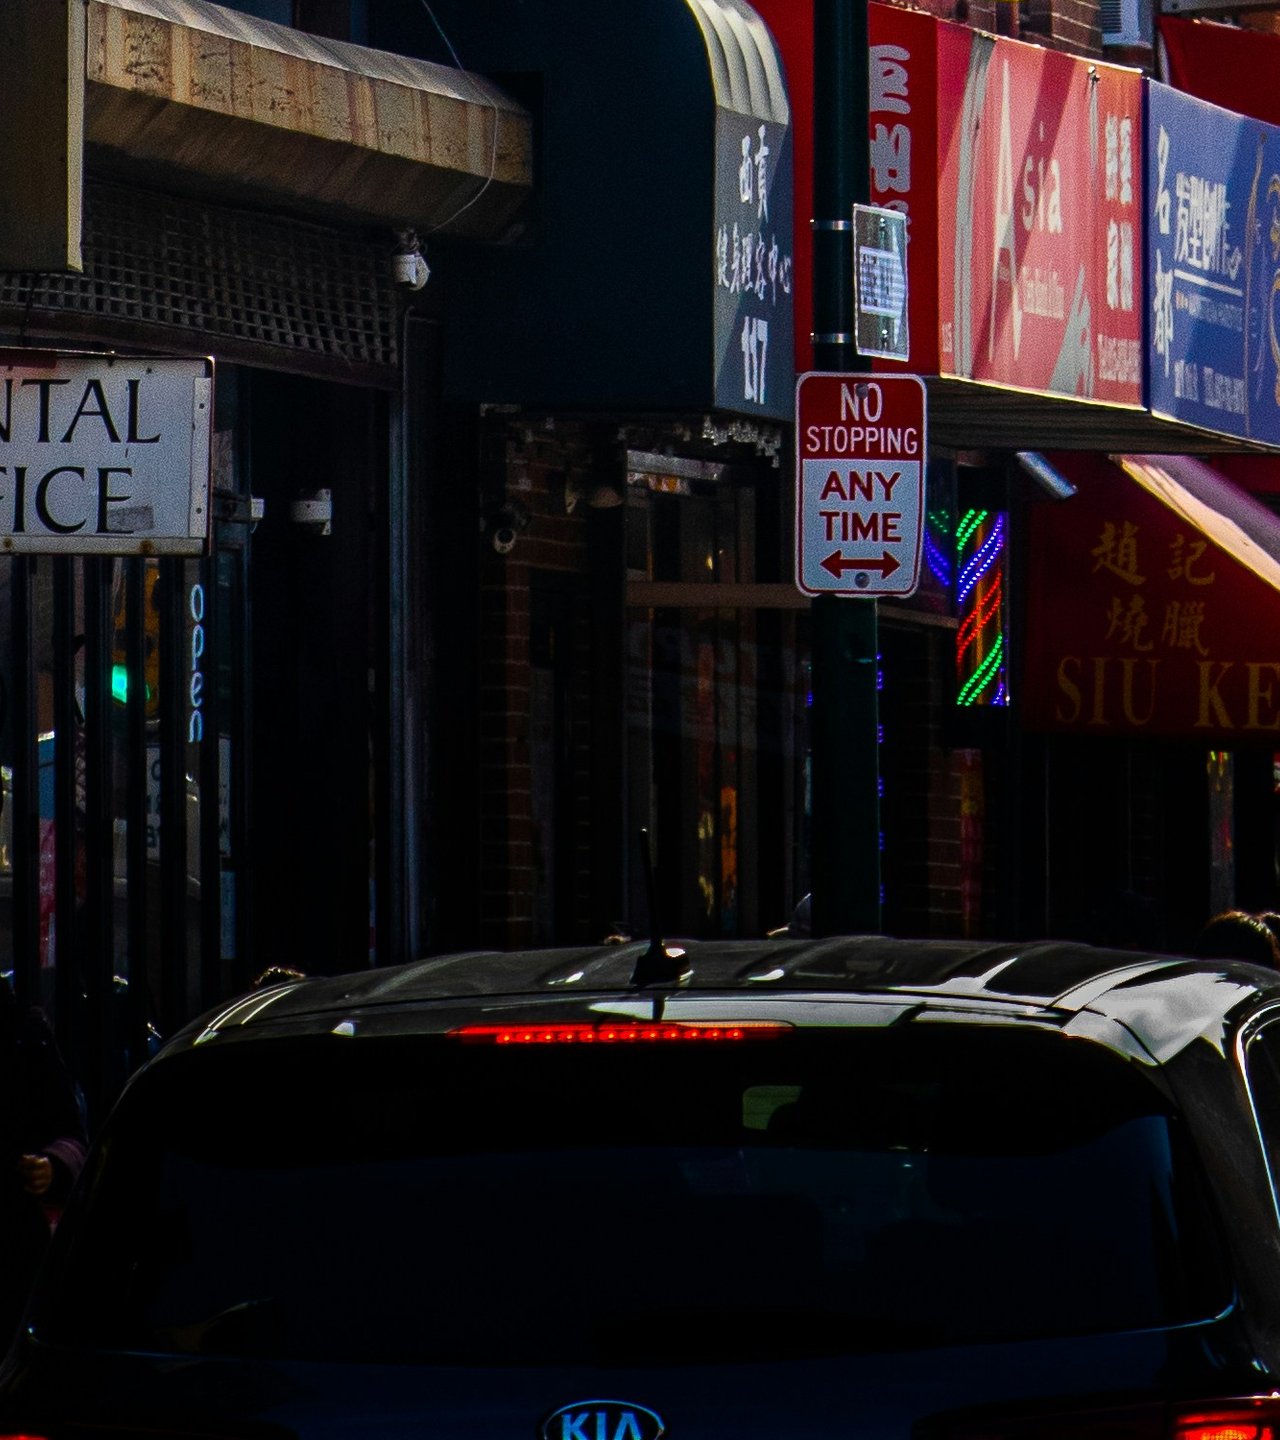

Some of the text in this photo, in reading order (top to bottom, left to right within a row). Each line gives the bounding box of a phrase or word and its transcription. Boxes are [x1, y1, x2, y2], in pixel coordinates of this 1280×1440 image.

[741, 316, 768, 405] 117
[840, 382, 884, 423] NO
[806, 425, 918, 455] STOPPING
[820, 470, 902, 502] ANY
[820, 511, 902, 543] TIME
[1056, 655, 1161, 729] SIU
